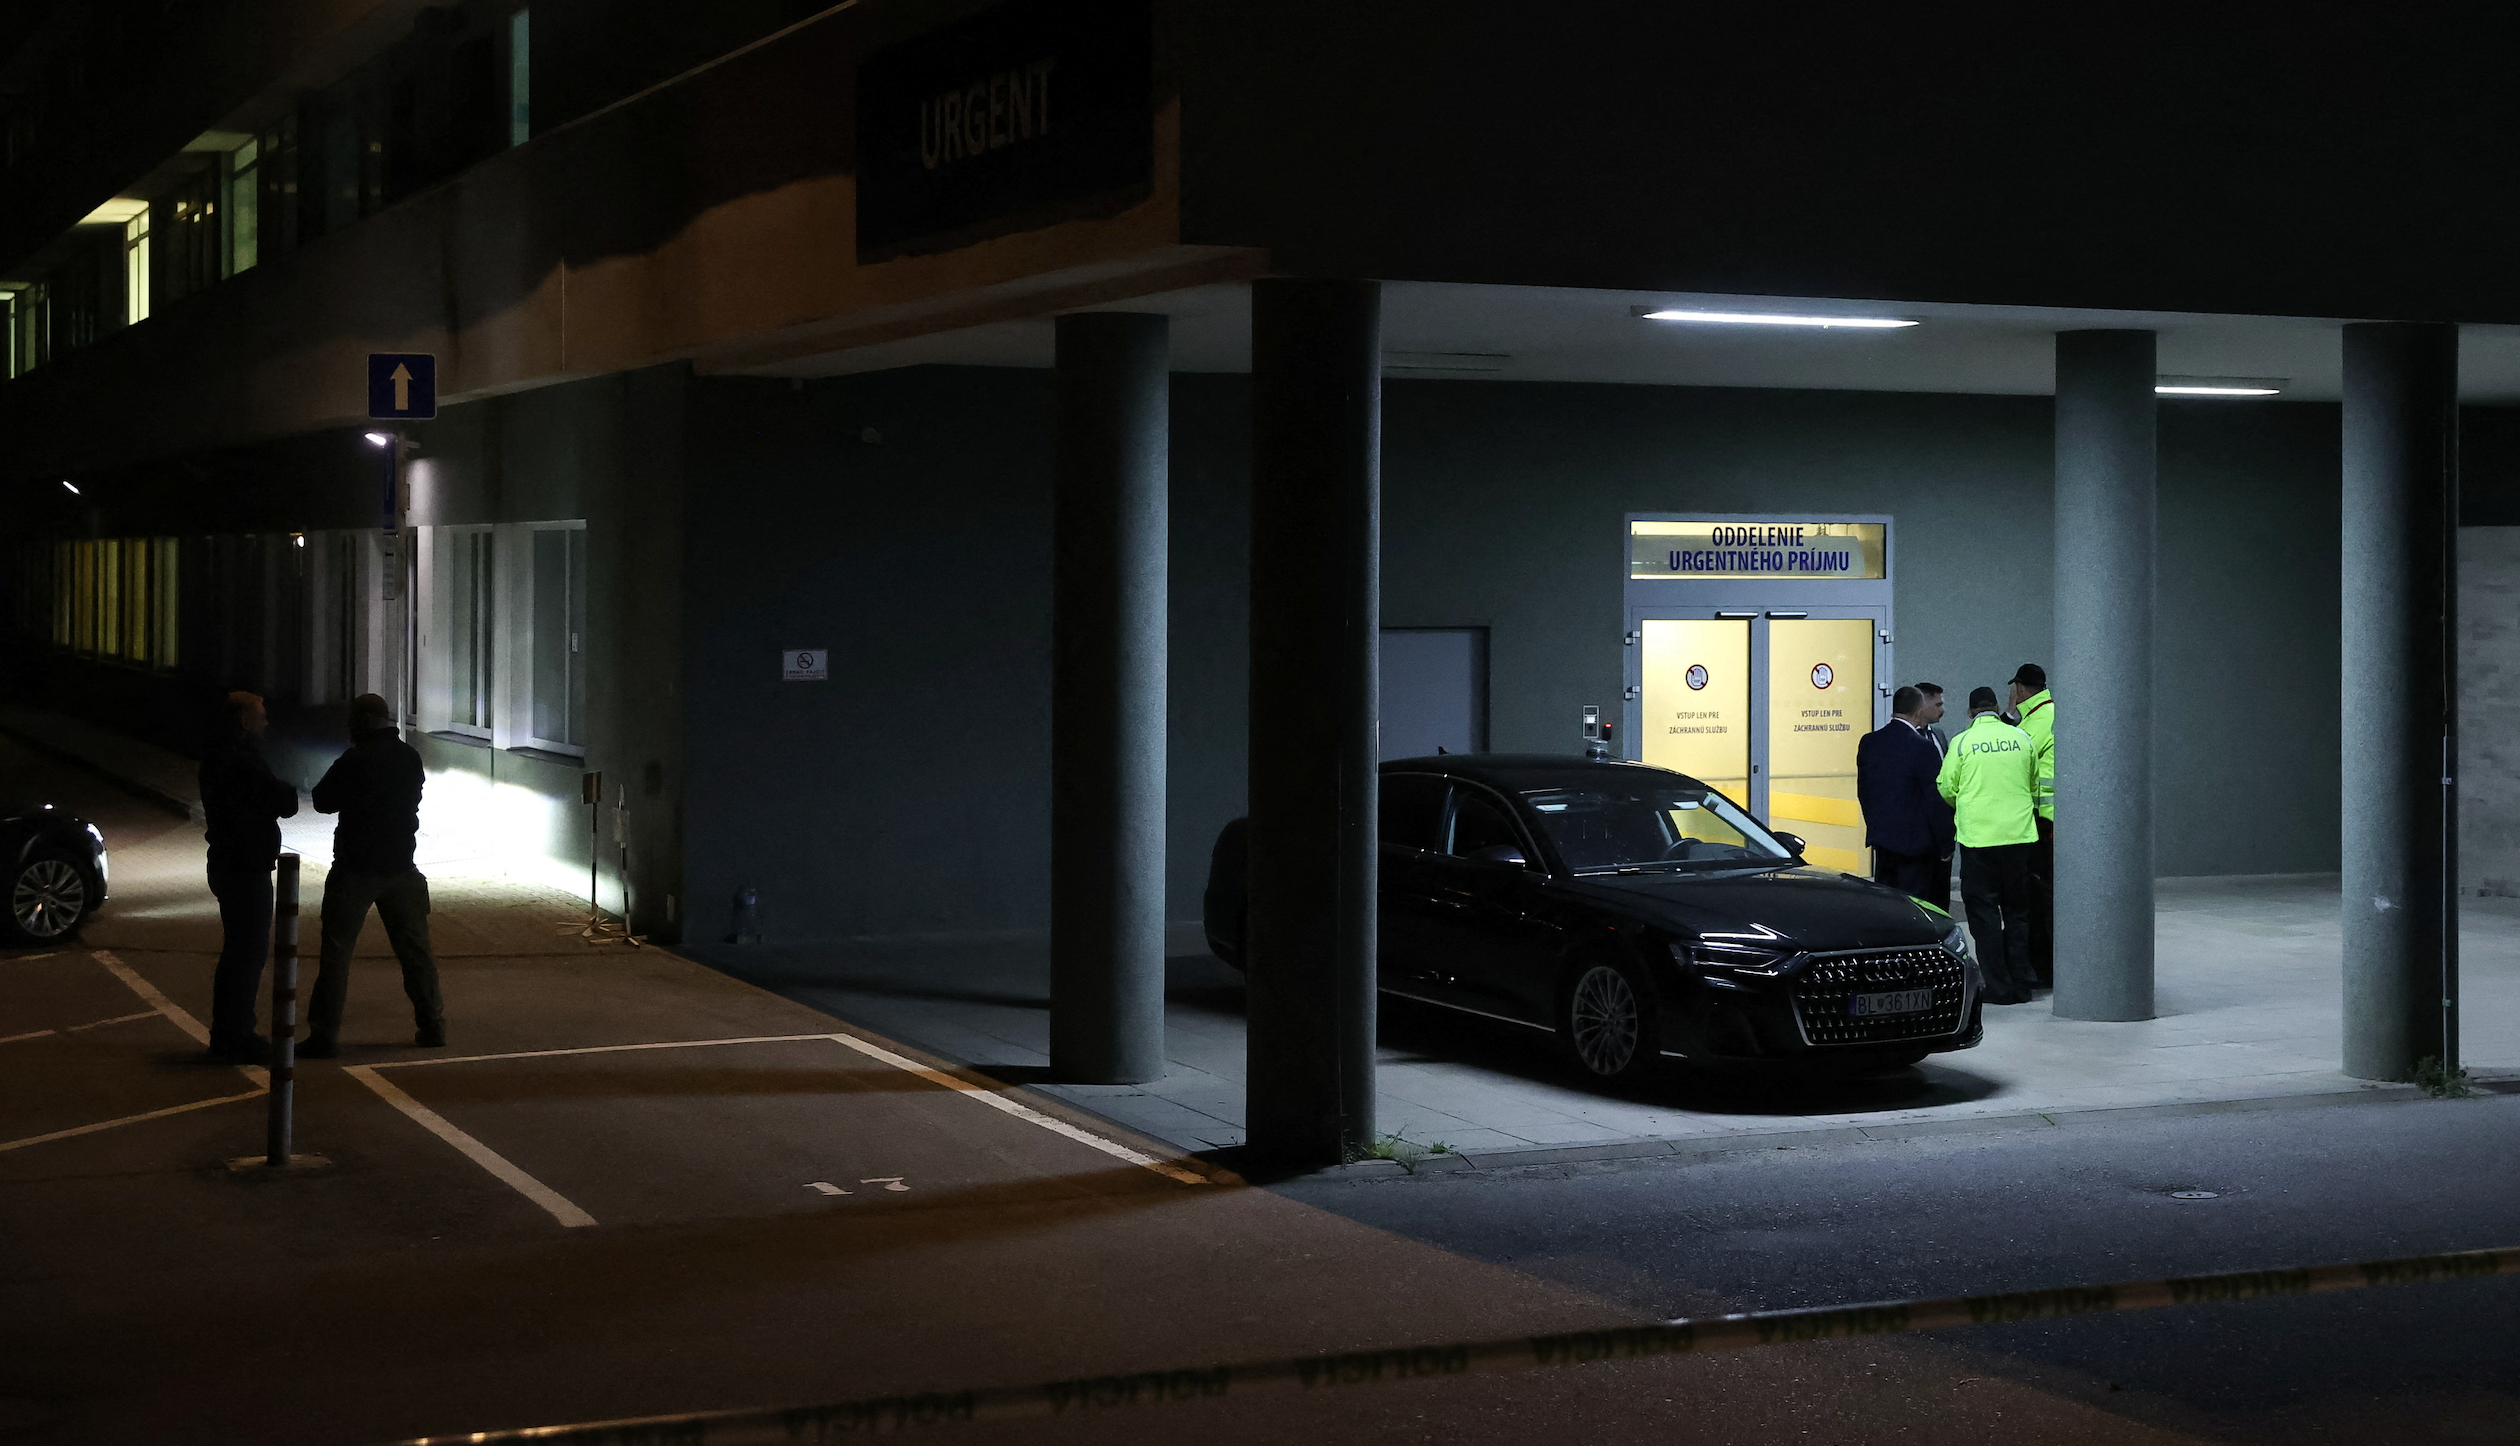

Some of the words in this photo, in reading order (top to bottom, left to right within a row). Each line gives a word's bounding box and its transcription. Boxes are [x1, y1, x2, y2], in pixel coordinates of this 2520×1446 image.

[920, 55, 1055, 170] URGENT
[1712, 526, 1804, 547] ODDELENIE
[1669, 547, 1783, 571] URGENTNÉHO
[1788, 547, 1850, 571] PRÍJMU
[1676, 711, 1695, 719] VSTUP
[1696, 711, 1707, 719] LEN
[1708, 711, 1719, 719] PRE
[1801, 709, 1819, 717] VSTUP
[1820, 709, 1831, 717] LEN
[1831, 709, 1843, 717] PRE
[1669, 725, 1704, 734] ZÁCHRANNÚ
[1705, 725, 1728, 734] SLUŽBU
[1794, 723, 1828, 732] ZÁCHRANNÚ
[1971, 738, 2021, 755] POLÍCIA
[1858, 996, 1877, 1014] BL
[1885, 991, 1930, 1012] 361XN
